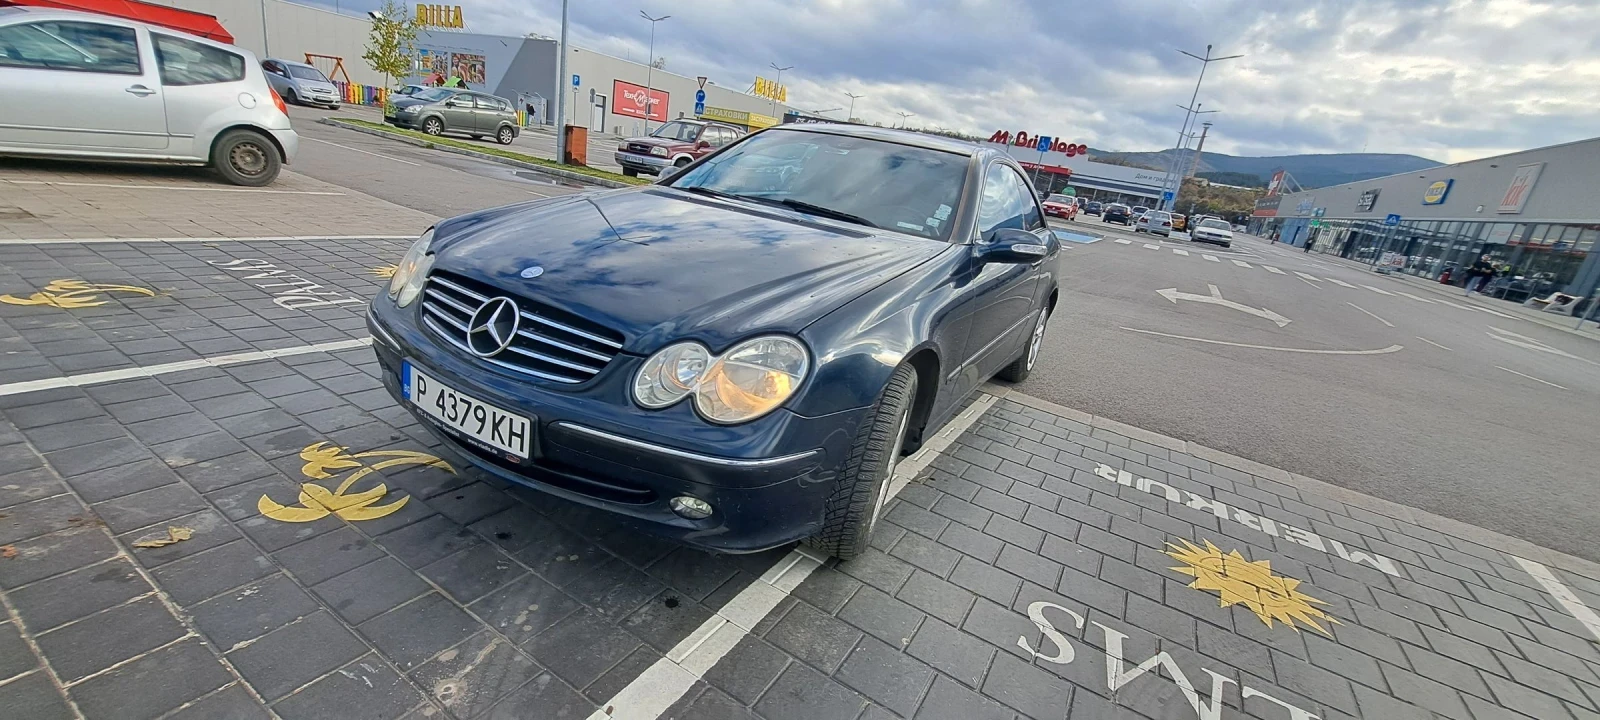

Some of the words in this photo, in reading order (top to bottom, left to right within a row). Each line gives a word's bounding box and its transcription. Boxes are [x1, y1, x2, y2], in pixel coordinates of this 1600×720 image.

[416, 3, 464, 29] BILLA
[754, 76, 787, 102] BILLA
[1014, 130, 1088, 157] Brilage
[207, 258, 365, 311] PALMS
[416, 374, 427, 402] P
[1094, 463, 1401, 578] MERKUR
